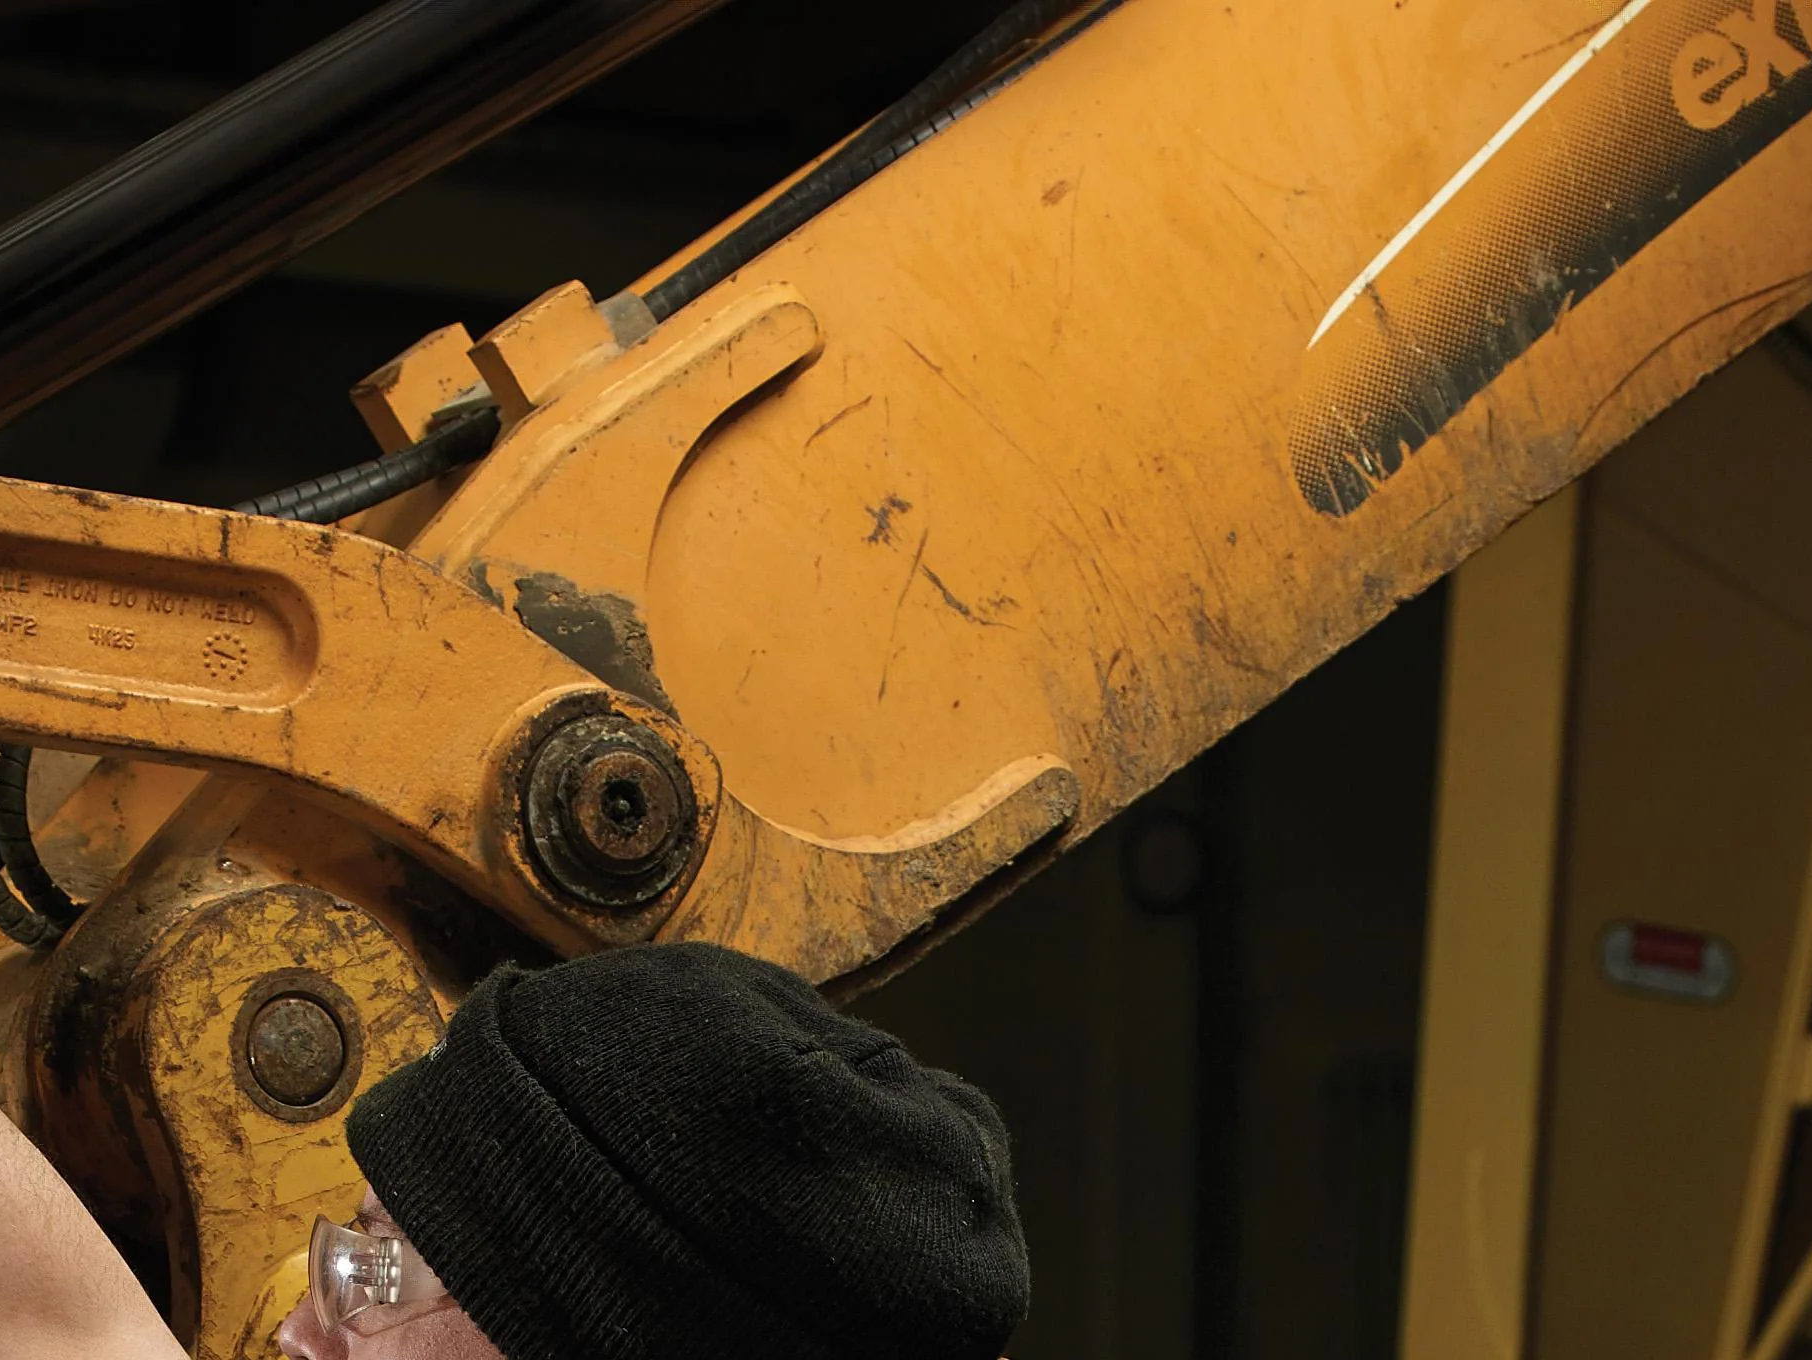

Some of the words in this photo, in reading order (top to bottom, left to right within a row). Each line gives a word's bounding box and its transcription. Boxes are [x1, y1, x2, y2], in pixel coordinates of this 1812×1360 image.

[43, 576, 99, 604] IRON
[109, 585, 138, 609] DO
[146, 591, 189, 616] NOT
[200, 600, 256, 626] WELD
